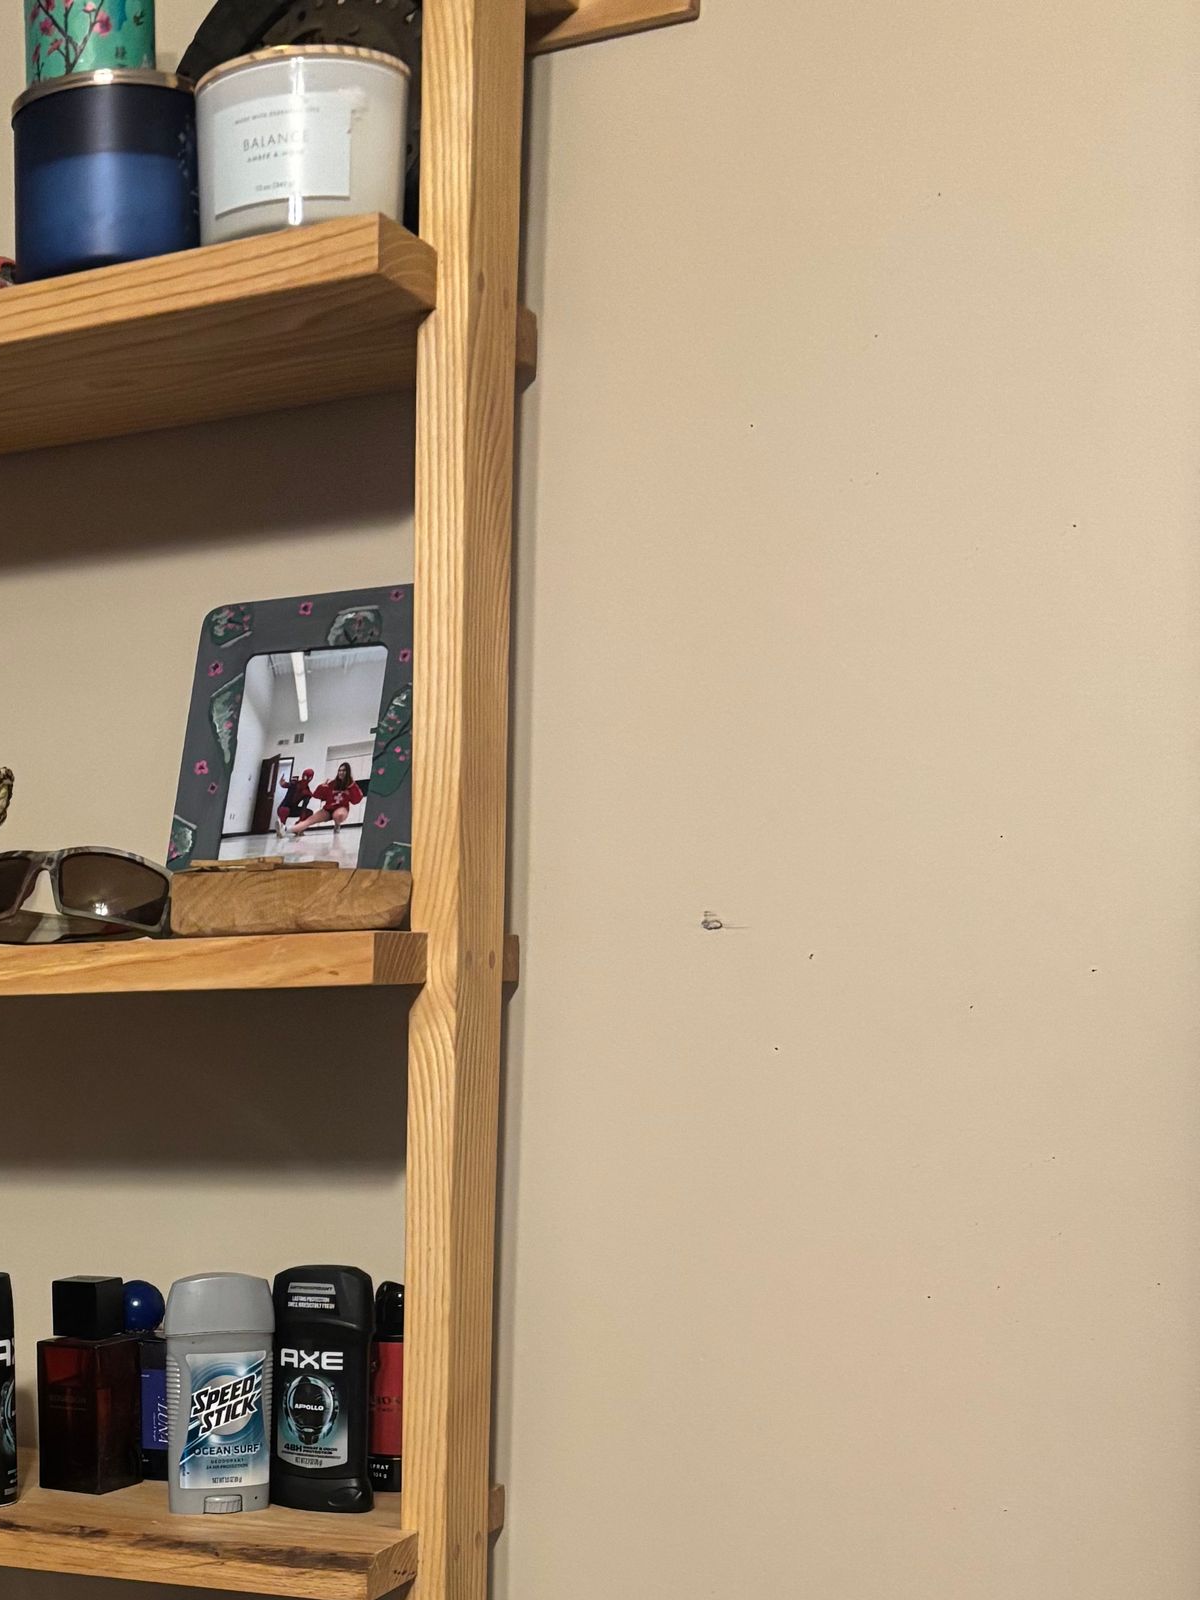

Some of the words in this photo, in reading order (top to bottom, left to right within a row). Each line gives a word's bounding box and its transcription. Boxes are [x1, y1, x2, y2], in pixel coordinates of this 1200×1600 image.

[281, 1348, 343, 1371] AXE
[192, 1374, 256, 1415] SPEED
[200, 1392, 257, 1434] STICK
[294, 1403, 324, 1411] APOLLO
[194, 1446, 231, 1456] OCEAN
[233, 1444, 260, 1454] SURF
